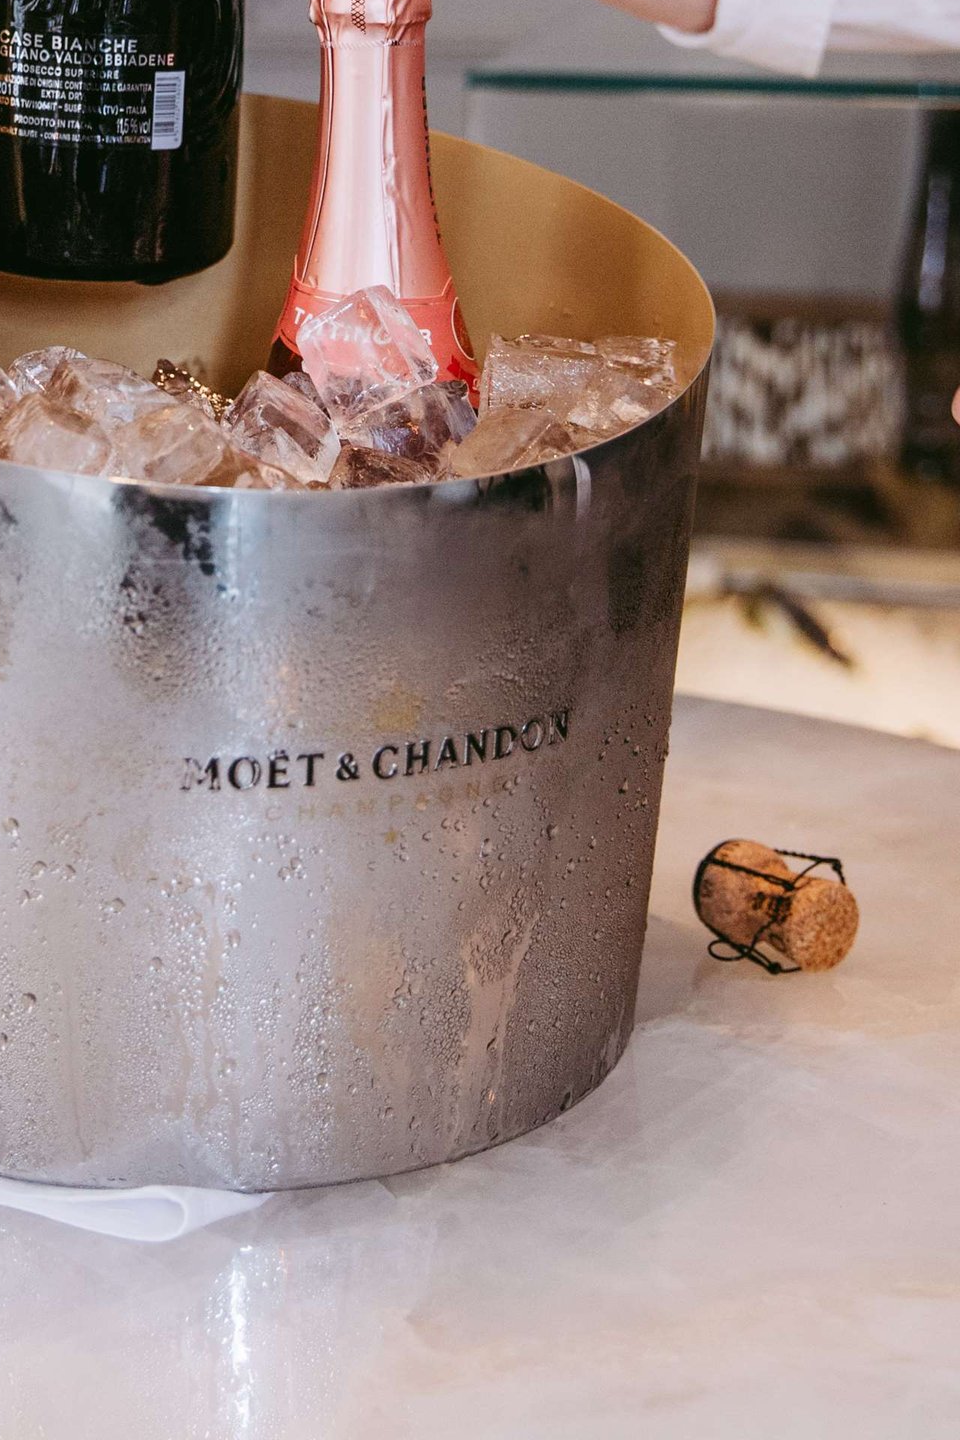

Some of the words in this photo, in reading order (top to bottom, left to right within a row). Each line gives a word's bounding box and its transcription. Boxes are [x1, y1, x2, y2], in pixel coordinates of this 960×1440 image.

[0, 29, 43, 48] CASE
[51, 35, 138, 54] BIANCHE
[54, 50, 175, 67] VALDOBBIADENE
[12, 62, 61, 77] PROSECCO
[41, 89, 66, 100] EXTRA
[14, 113, 56, 128] PRODOTTO
[179, 749, 325, 791] MOËT
[335, 752, 360, 781] &
[371, 709, 570, 780] CHANDON
